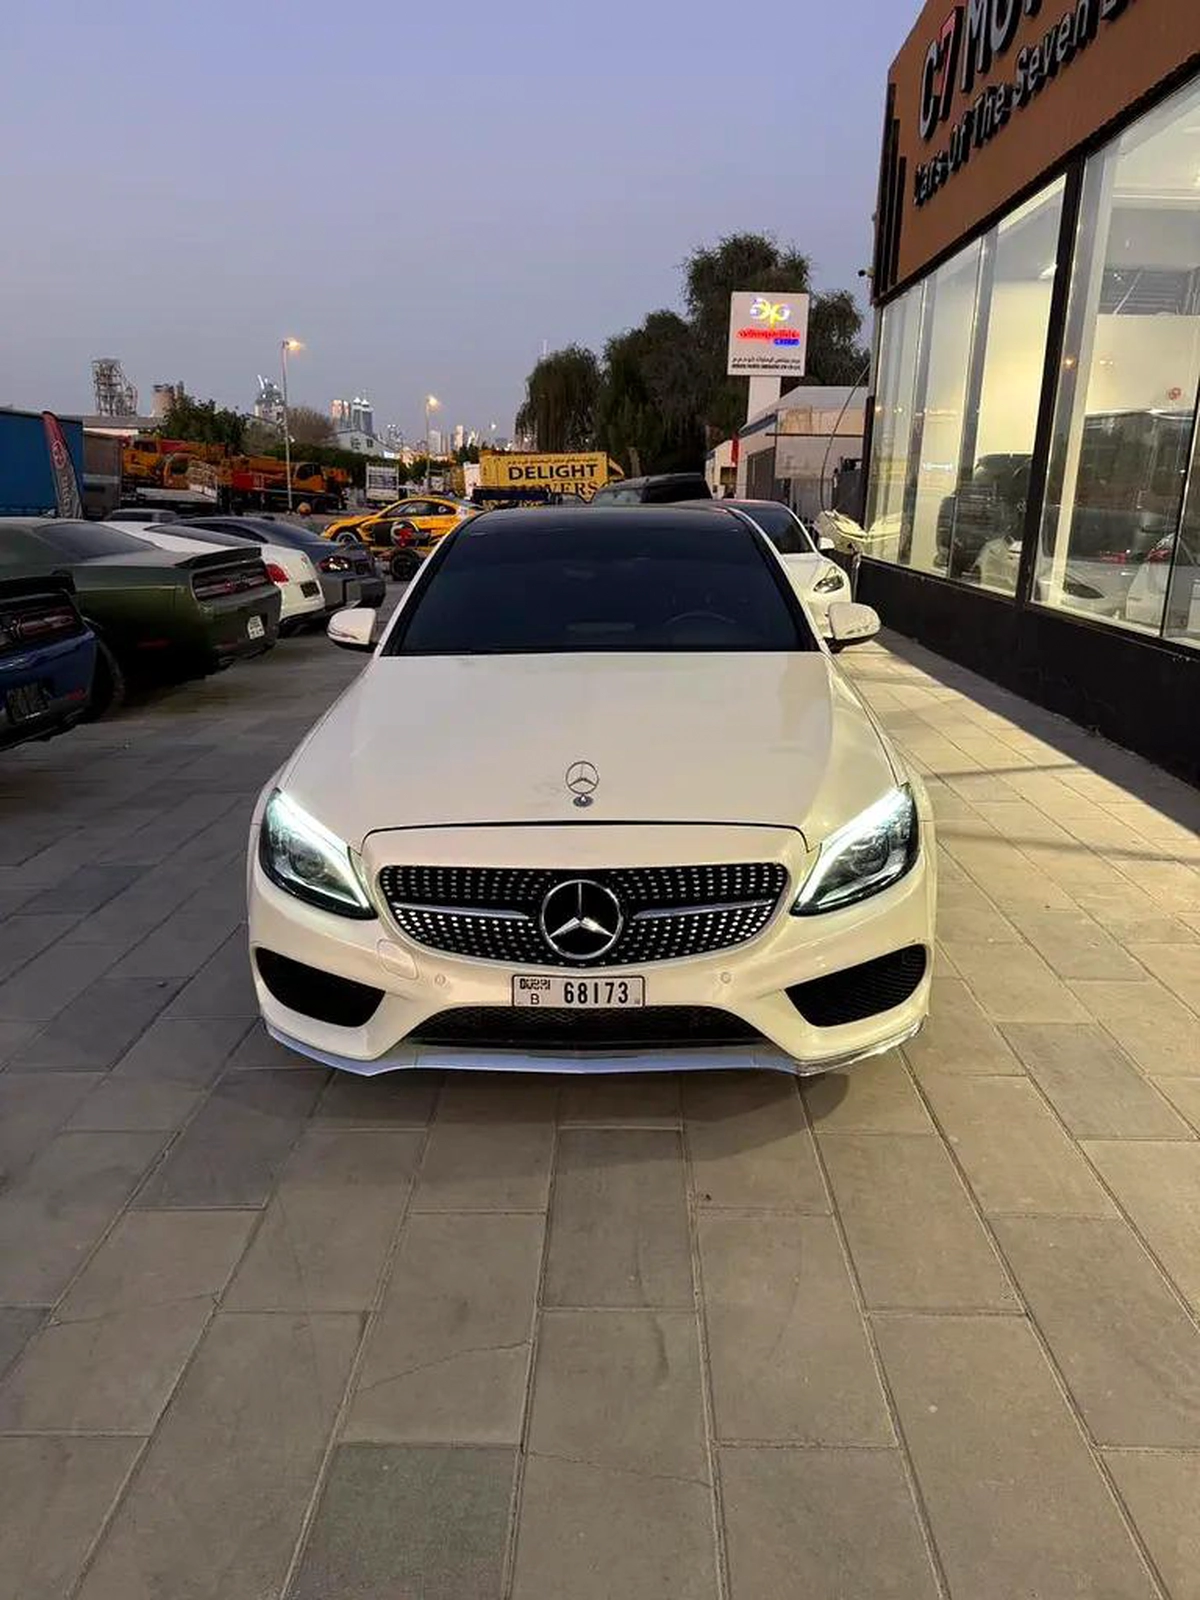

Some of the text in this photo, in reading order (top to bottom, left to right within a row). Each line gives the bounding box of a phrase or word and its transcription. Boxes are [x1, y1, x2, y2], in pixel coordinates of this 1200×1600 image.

[919, 5, 964, 141] C7
[971, 85, 1012, 149] The
[1012, 0, 1099, 112] Seven
[508, 464, 598, 480] DELIGHT
[530, 982, 629, 1005] B 68173
